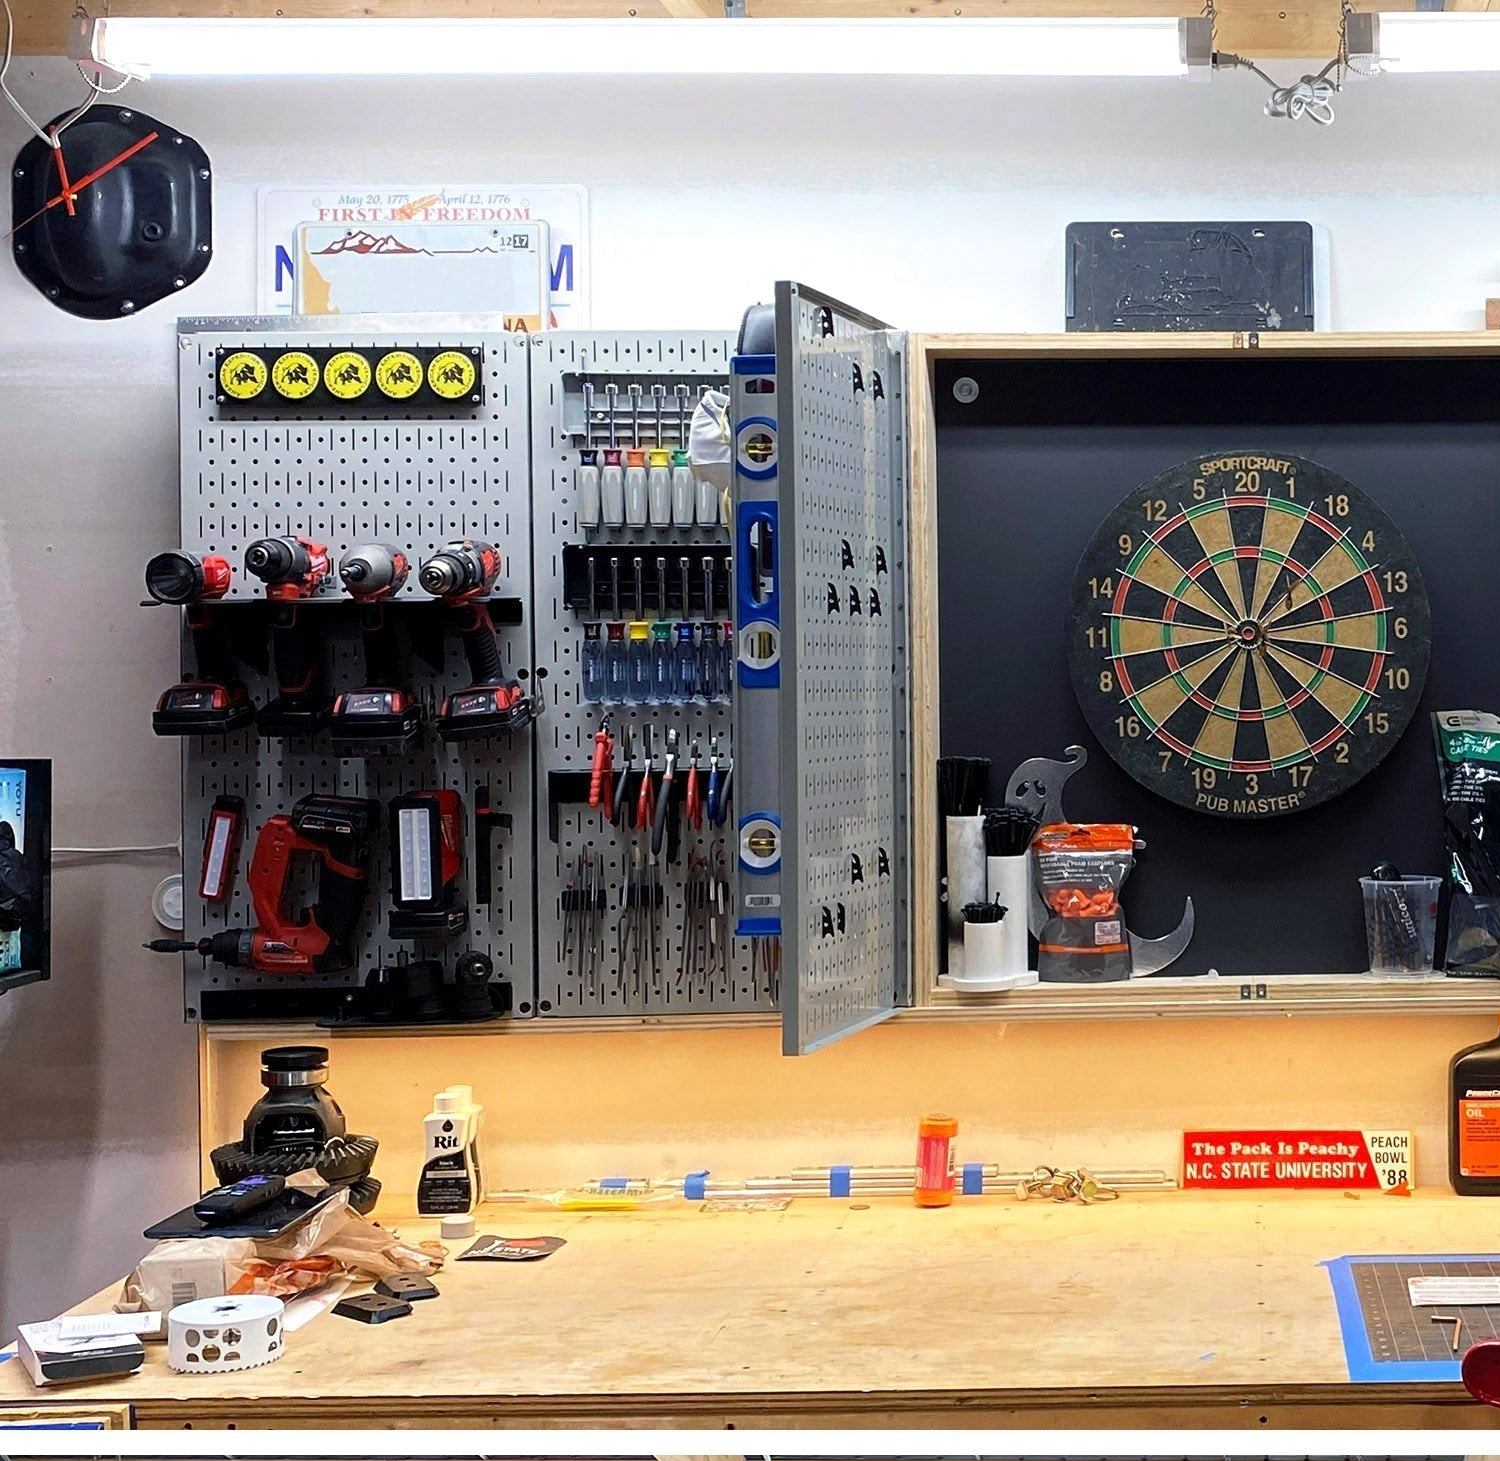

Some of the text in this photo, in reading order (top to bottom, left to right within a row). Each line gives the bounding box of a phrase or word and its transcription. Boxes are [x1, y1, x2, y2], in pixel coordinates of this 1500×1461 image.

[338, 195, 363, 206] May
[387, 195, 409, 204] 1775
[488, 195, 510, 204] 1776
[318, 208, 382, 221] FIRST
[423, 208, 531, 221] FREEDOM
[500, 235, 528, 248] 12 17
[1192, 479, 1206, 499] 5
[1234, 471, 1260, 492] 20
[1286, 478, 1295, 497] 1
[1143, 500, 1167, 521] 12
[1325, 495, 1349, 516] 18
[1118, 535, 1133, 555] 9
[1362, 532, 1375, 552] 4
[1088, 578, 1113, 598] 14
[1383, 572, 1408, 593] 13
[1085, 627, 1107, 648] 11
[1394, 618, 1408, 639] 6
[1099, 671, 1113, 692] 8
[1384, 669, 1409, 690] 10
[1115, 716, 1140, 738] 16
[1364, 713, 1389, 734] 15
[1159, 752, 1172, 772] 7
[1335, 743, 1349, 763] 2
[1192, 768, 1216, 789] 19
[1245, 774, 1259, 795] 3
[1289, 766, 1313, 787] 17
[1196, 793, 1228, 812] PUB
[1466, 1108, 1485, 1118] OIL
[434, 1135, 460, 1149] Rit
[1192, 1142, 1360, 1160] The Pack Is Peachy
[1371, 1136, 1408, 1148] PEACH
[1375, 1151, 1408, 1164] BOWL
[1186, 1162, 1367, 1179] N.C. STATE UNIVERSITY
